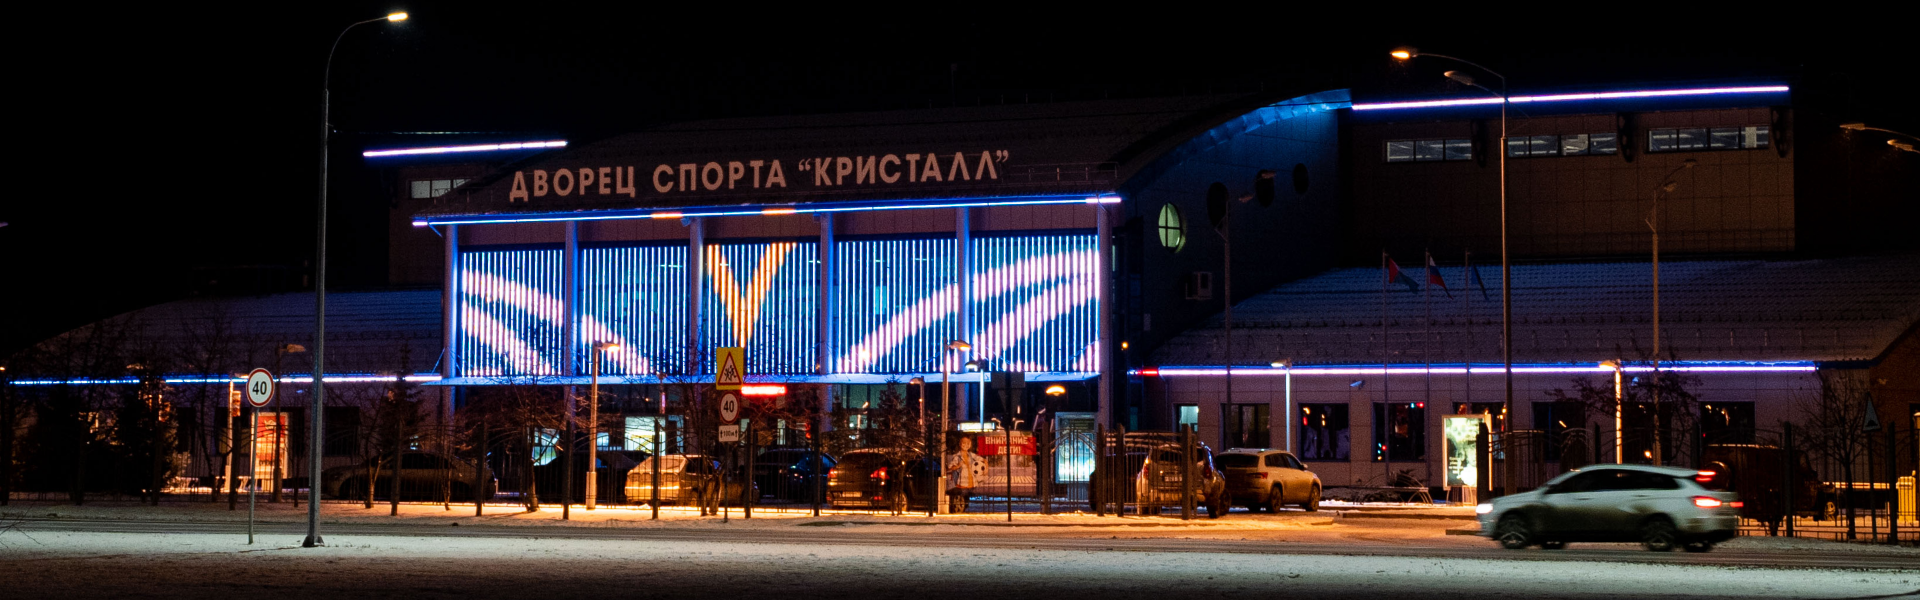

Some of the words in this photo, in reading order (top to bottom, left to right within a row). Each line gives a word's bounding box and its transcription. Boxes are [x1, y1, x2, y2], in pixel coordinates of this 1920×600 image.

[509, 166, 636, 202] ДВОРЕЦ
[652, 159, 787, 193] СПОРТА
[252, 380, 267, 396] 40
[723, 400, 735, 413] 40
